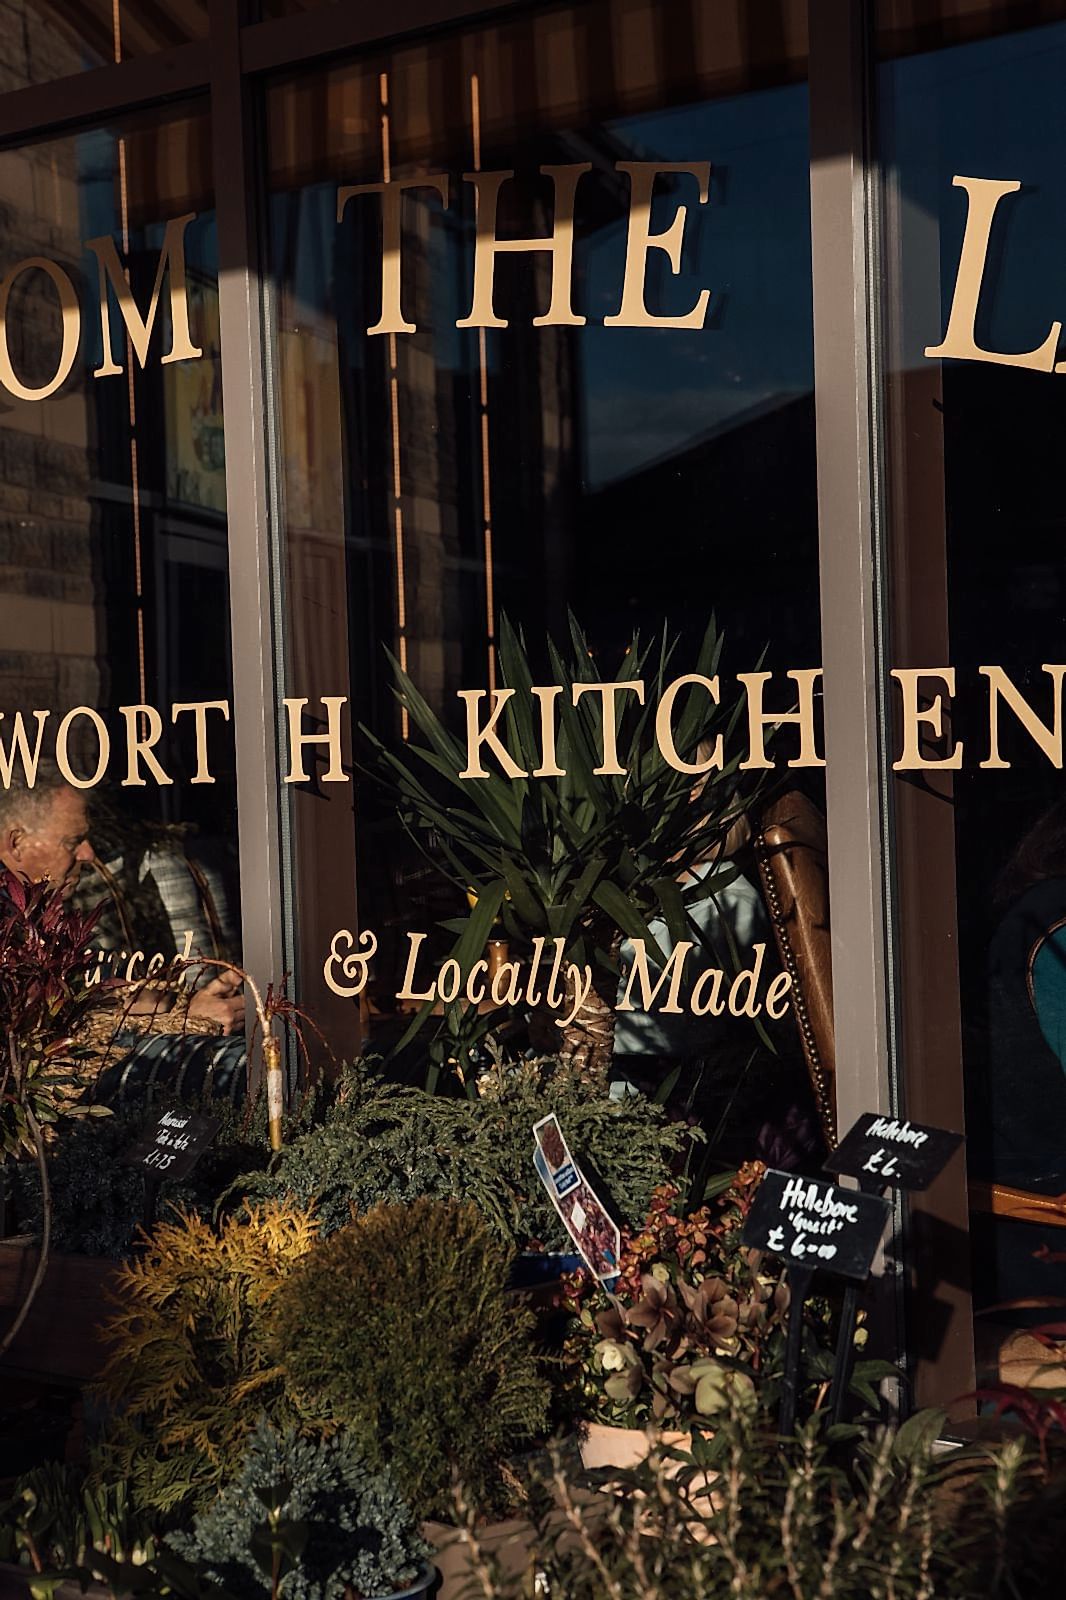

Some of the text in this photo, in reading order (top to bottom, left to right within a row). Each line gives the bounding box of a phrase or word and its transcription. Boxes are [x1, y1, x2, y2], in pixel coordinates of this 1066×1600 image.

[0, 161, 1066, 401] OM THE L
[457, 664, 1066, 779] KITCHEN
[323, 929, 796, 1028] & Locally Made
[779, 1177, 858, 1224] Hellebore
